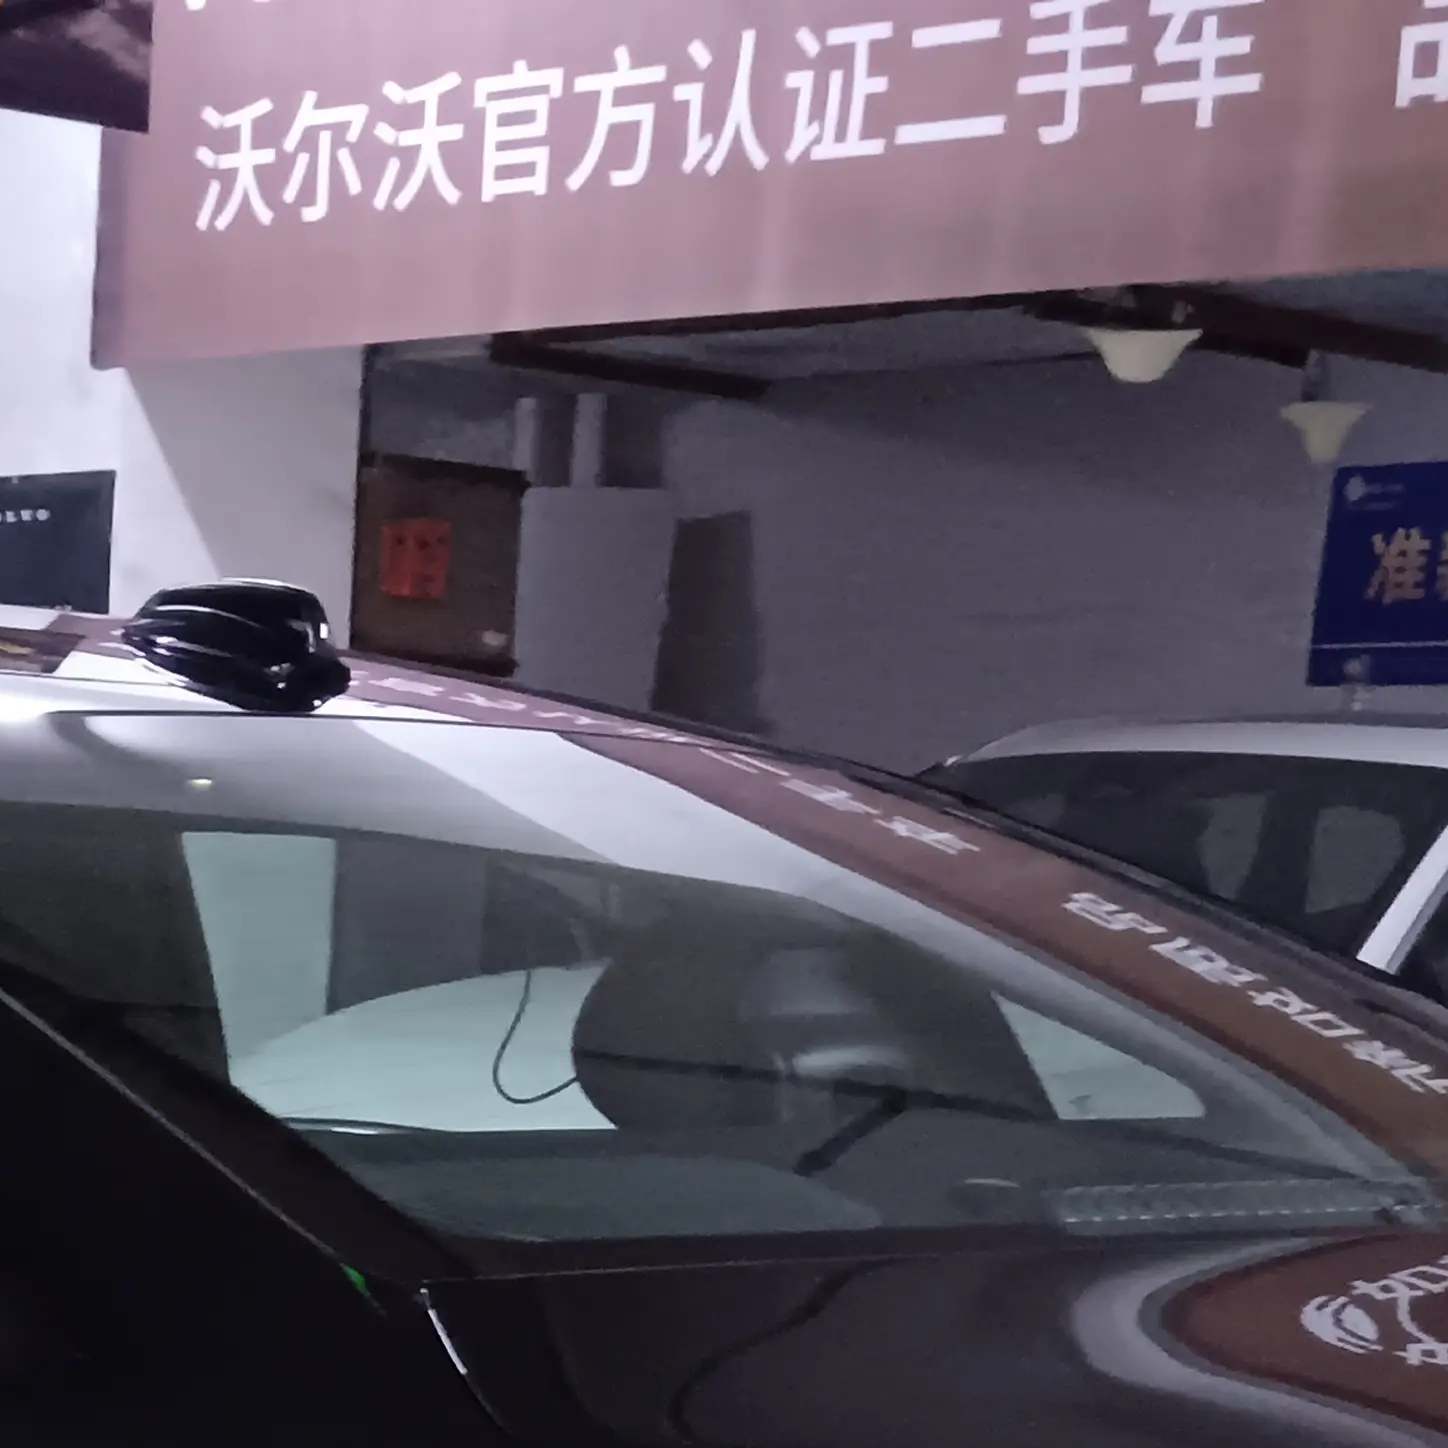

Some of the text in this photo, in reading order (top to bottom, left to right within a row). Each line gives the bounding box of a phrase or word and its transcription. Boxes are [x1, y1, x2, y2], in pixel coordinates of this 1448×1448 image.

[193, 0, 1264, 232] 沃尔沃官方认证二手车
